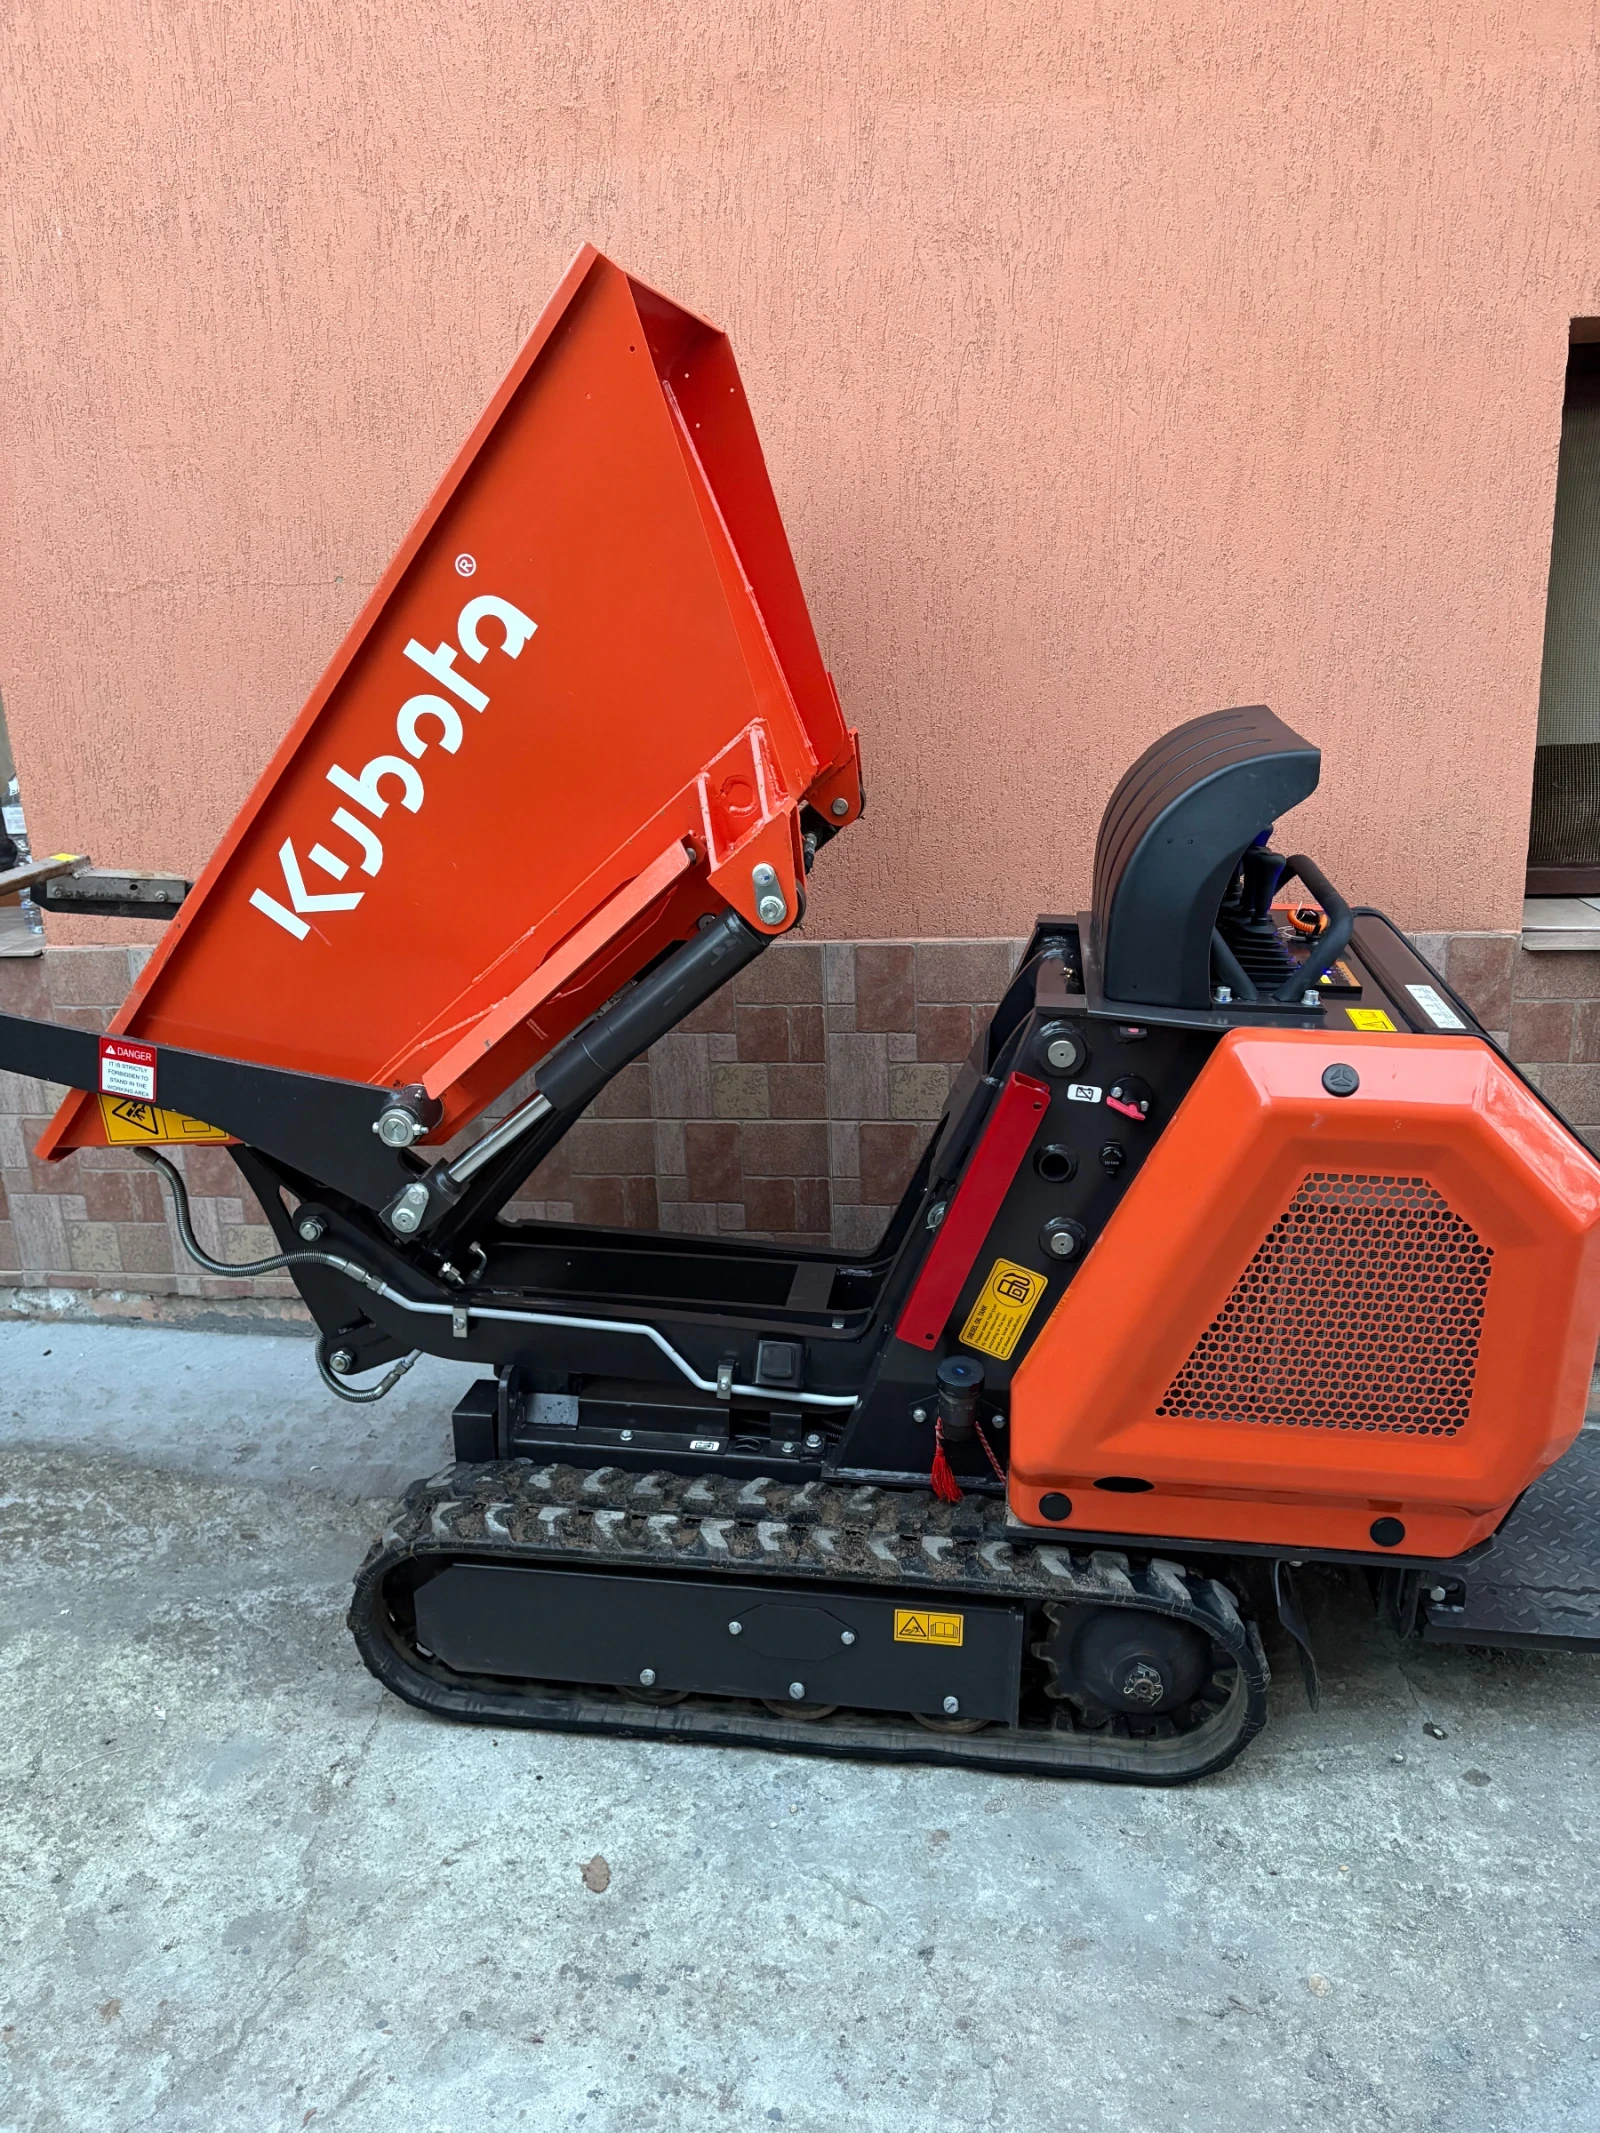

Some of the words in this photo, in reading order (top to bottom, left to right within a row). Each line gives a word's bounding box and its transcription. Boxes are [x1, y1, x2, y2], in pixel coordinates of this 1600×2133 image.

[249, 595, 538, 941] Kubota
[117, 1046, 152, 1062] DANGER
[108, 1068, 140, 1080] FORBIDDEN
[122, 1063, 148, 1074] STRICTLY
[109, 1076, 128, 1086] STAND
[107, 1084, 134, 1094] WORKING
[134, 1089, 150, 1097] AREA
[966, 1323, 979, 1340] DIESEL
[977, 1303, 988, 1317] TANK
